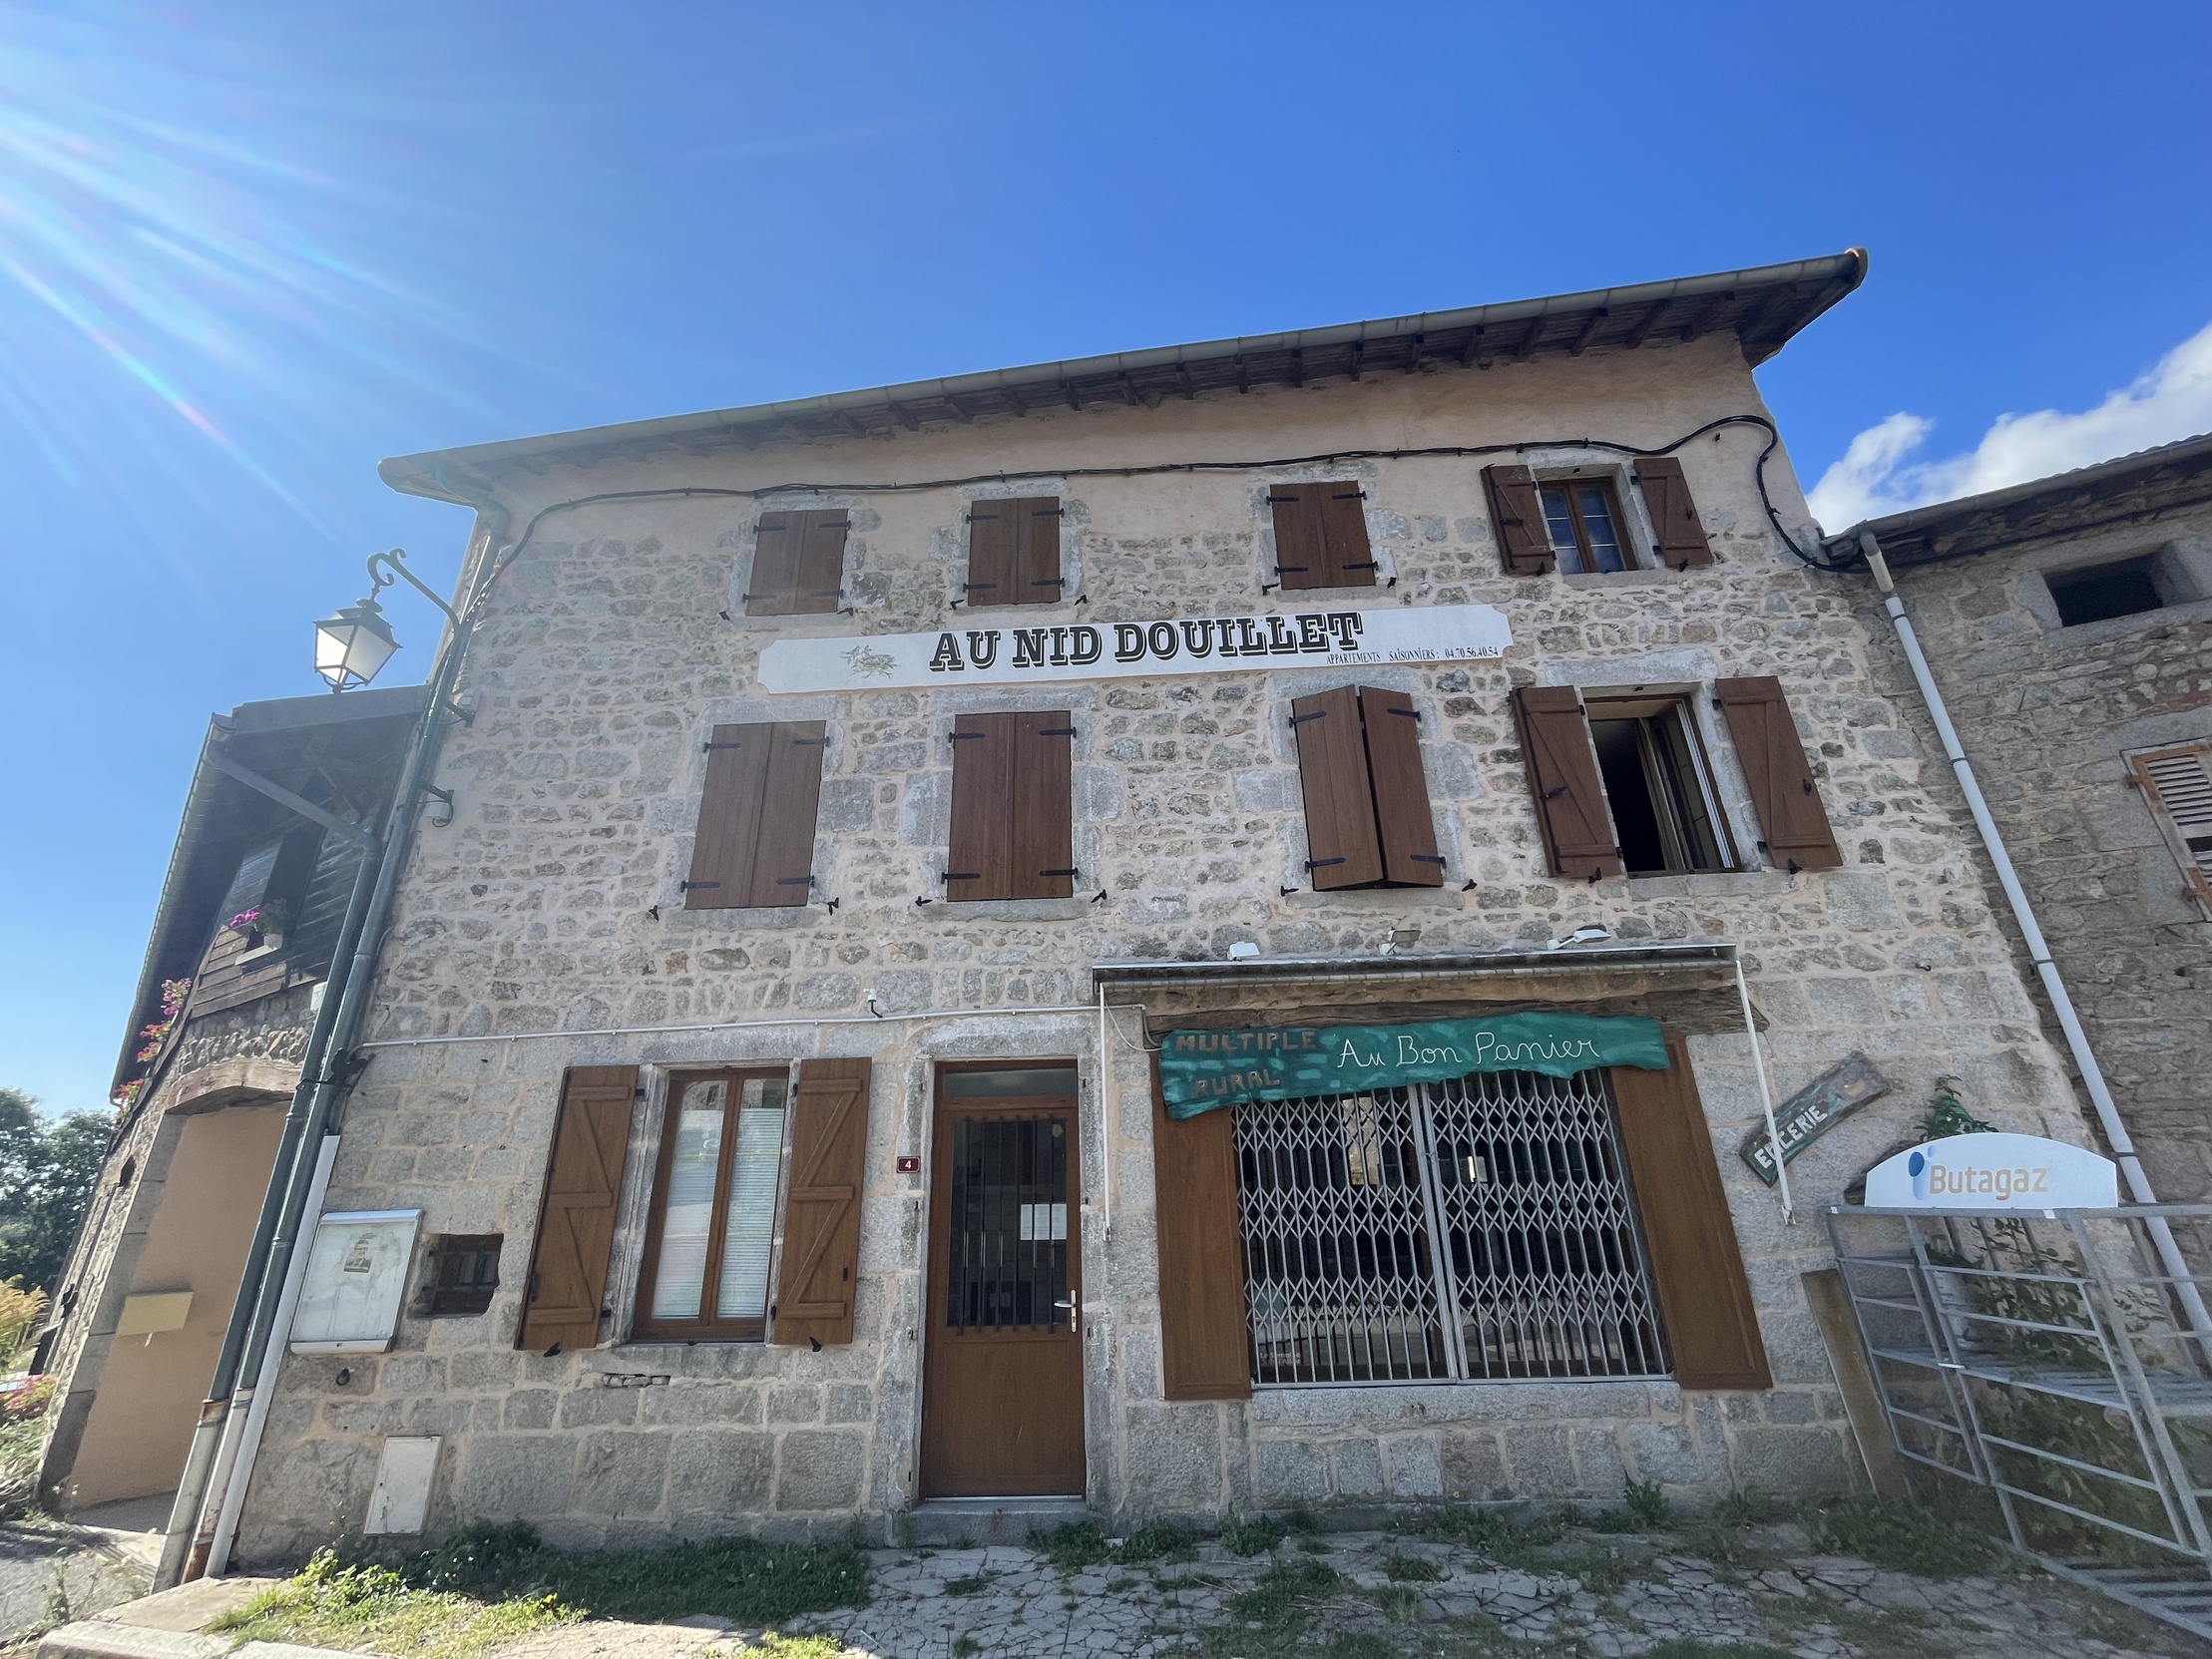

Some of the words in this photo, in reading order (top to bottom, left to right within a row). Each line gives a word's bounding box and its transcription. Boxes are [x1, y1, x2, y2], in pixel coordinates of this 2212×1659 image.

[929, 630, 1001, 671] AU
[1012, 625, 1103, 667] NID
[1113, 612, 1364, 662] DOUILLET
[1327, 651, 1381, 664] APPARTEMENTS
[1176, 1031, 1317, 1051] MULTIPLE
[1337, 1038, 1386, 1067] Au
[1396, 1036, 1463, 1066] Bon
[1475, 1032, 1600, 1064] Panier
[1195, 1068, 1280, 1096] RURAL
[1754, 1104, 1828, 1169] EPCERIE
[904, 1159, 912, 1169] 4
[1929, 1164, 2048, 1201] Butagaz
